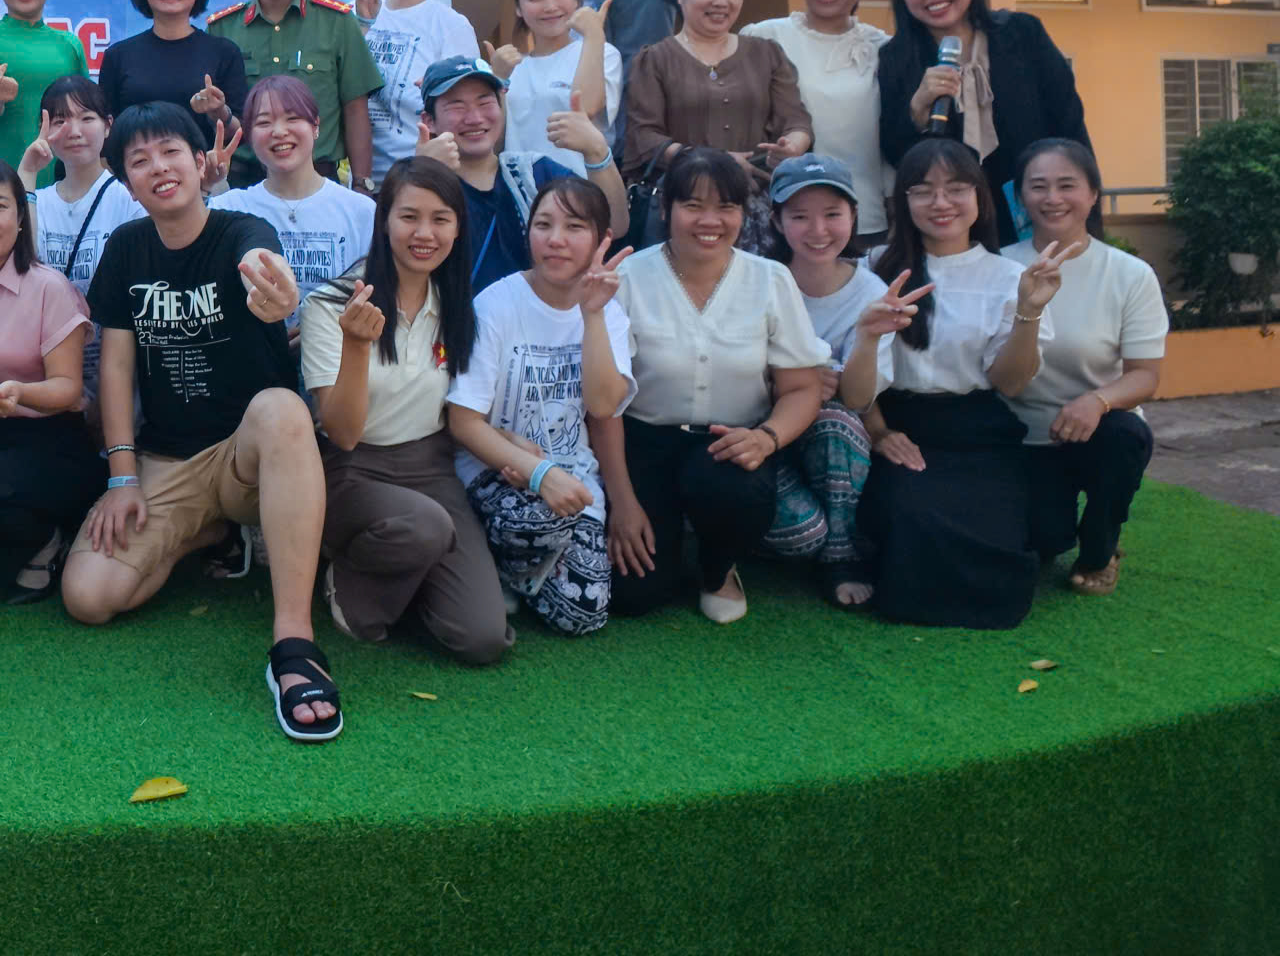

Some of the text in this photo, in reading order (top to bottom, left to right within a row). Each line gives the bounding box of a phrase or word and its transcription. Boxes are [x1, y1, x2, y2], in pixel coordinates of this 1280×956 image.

[291, 250, 305, 264] AND
[306, 250, 332, 266] MOVIES
[304, 267, 329, 283] WORLD
